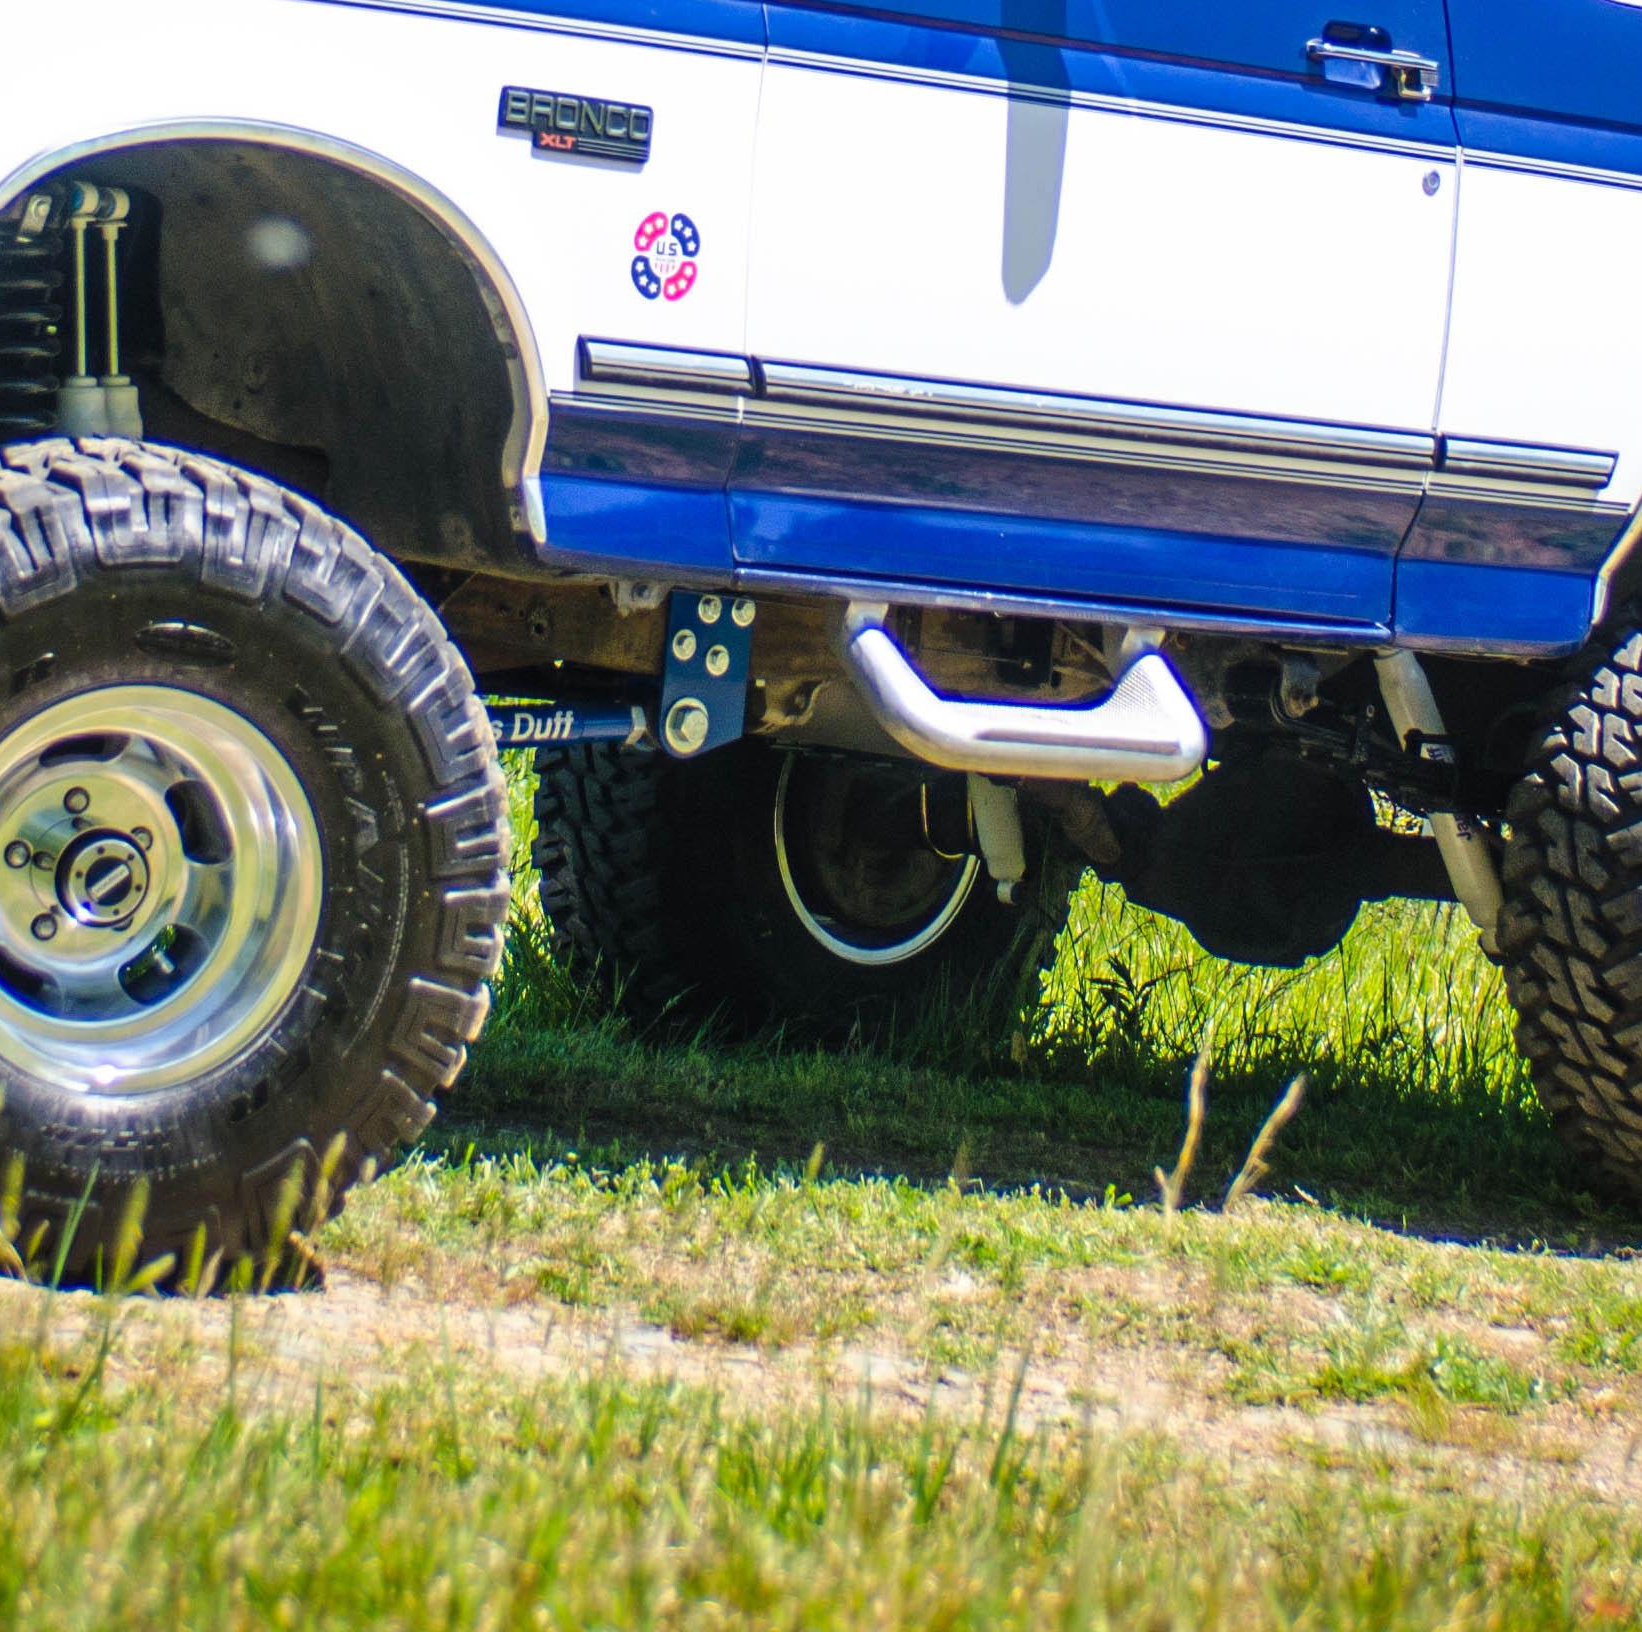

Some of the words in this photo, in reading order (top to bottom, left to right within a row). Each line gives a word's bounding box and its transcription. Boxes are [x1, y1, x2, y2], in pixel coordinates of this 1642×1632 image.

[504, 89, 652, 141] BRONCO
[539, 131, 576, 150] XLT
[510, 709, 575, 741] Duff
